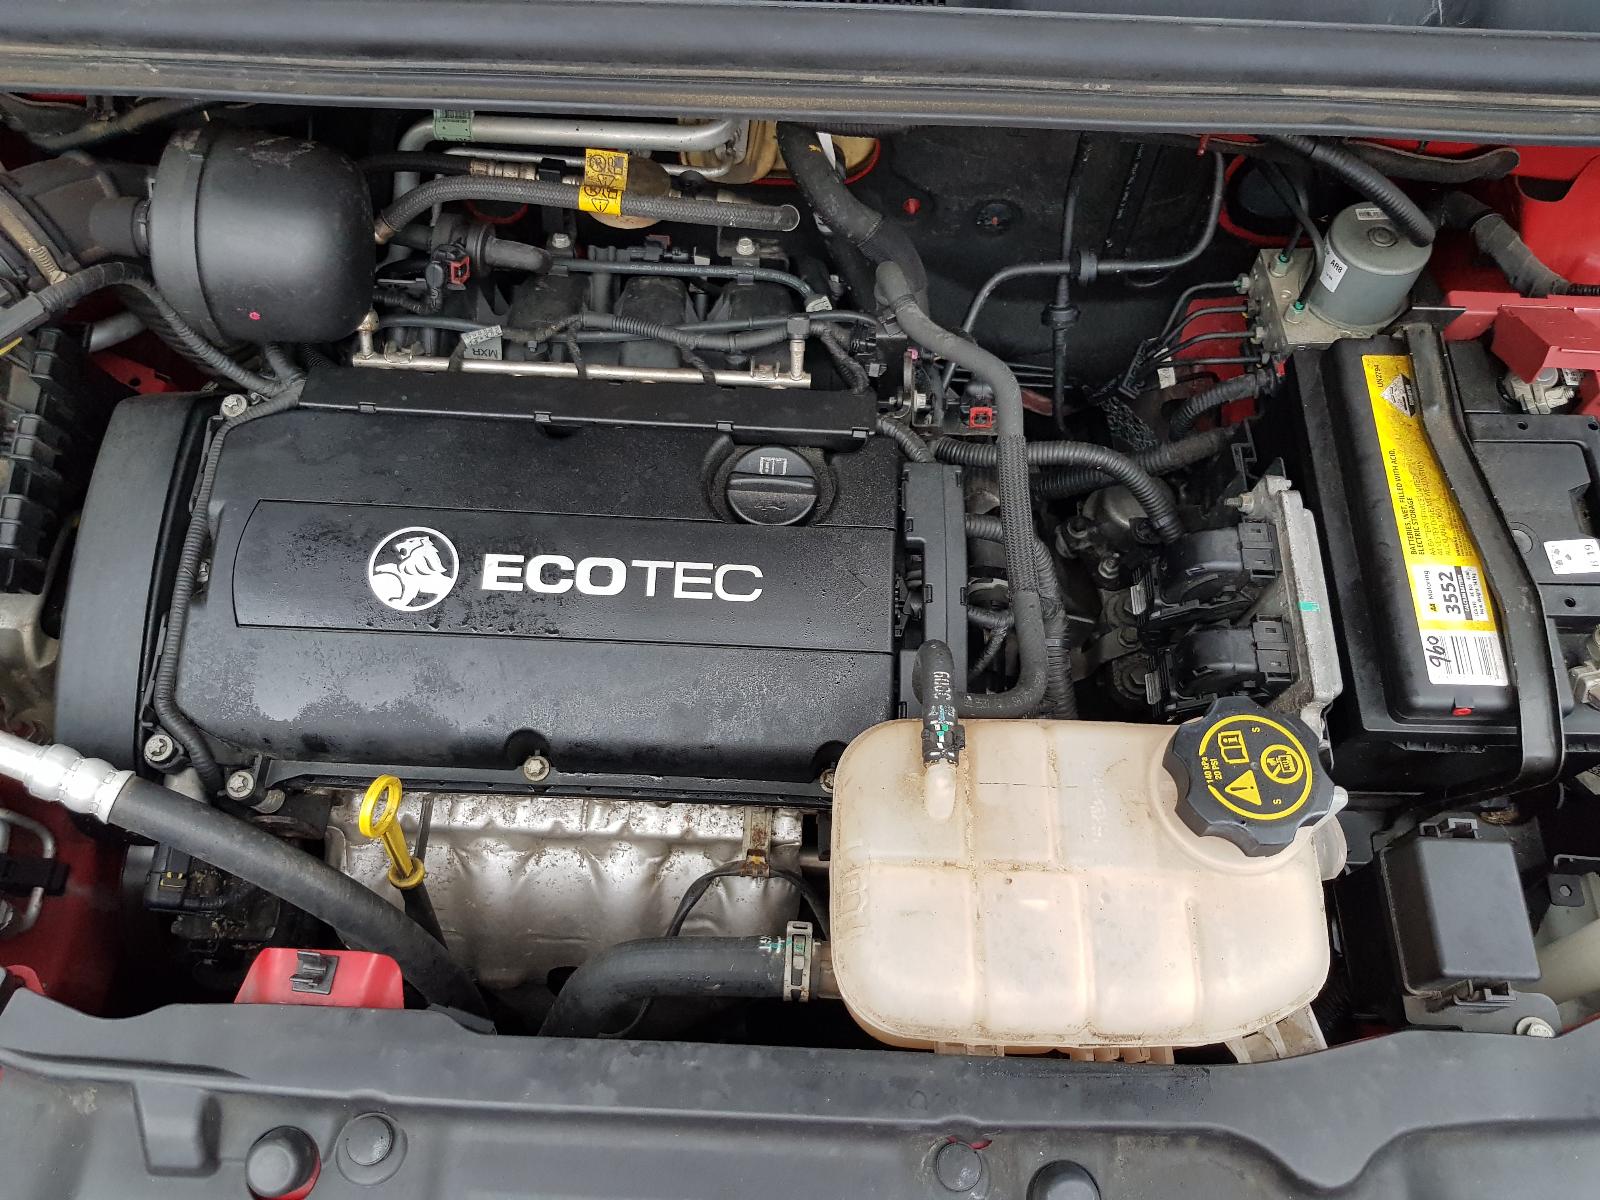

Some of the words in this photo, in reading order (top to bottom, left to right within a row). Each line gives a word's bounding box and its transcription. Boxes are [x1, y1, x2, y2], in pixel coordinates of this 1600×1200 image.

[472, 347, 498, 358] MXR
[1374, 365, 1383, 387] UN2794
[1401, 505, 1409, 519] WET,
[1408, 497, 1418, 525] STORAGE
[1406, 521, 1415, 554] BATTERIES,
[1415, 527, 1424, 555] ELECTRIC
[481, 553, 763, 602] ECOTEC
[1423, 571, 1433, 599] Motoring
[1438, 572, 1461, 614] 3552
[1426, 636, 1451, 667] 960
[1205, 771, 1213, 783] 140
[1210, 758, 1219, 769] PSI
[1215, 771, 1222, 780] 20
